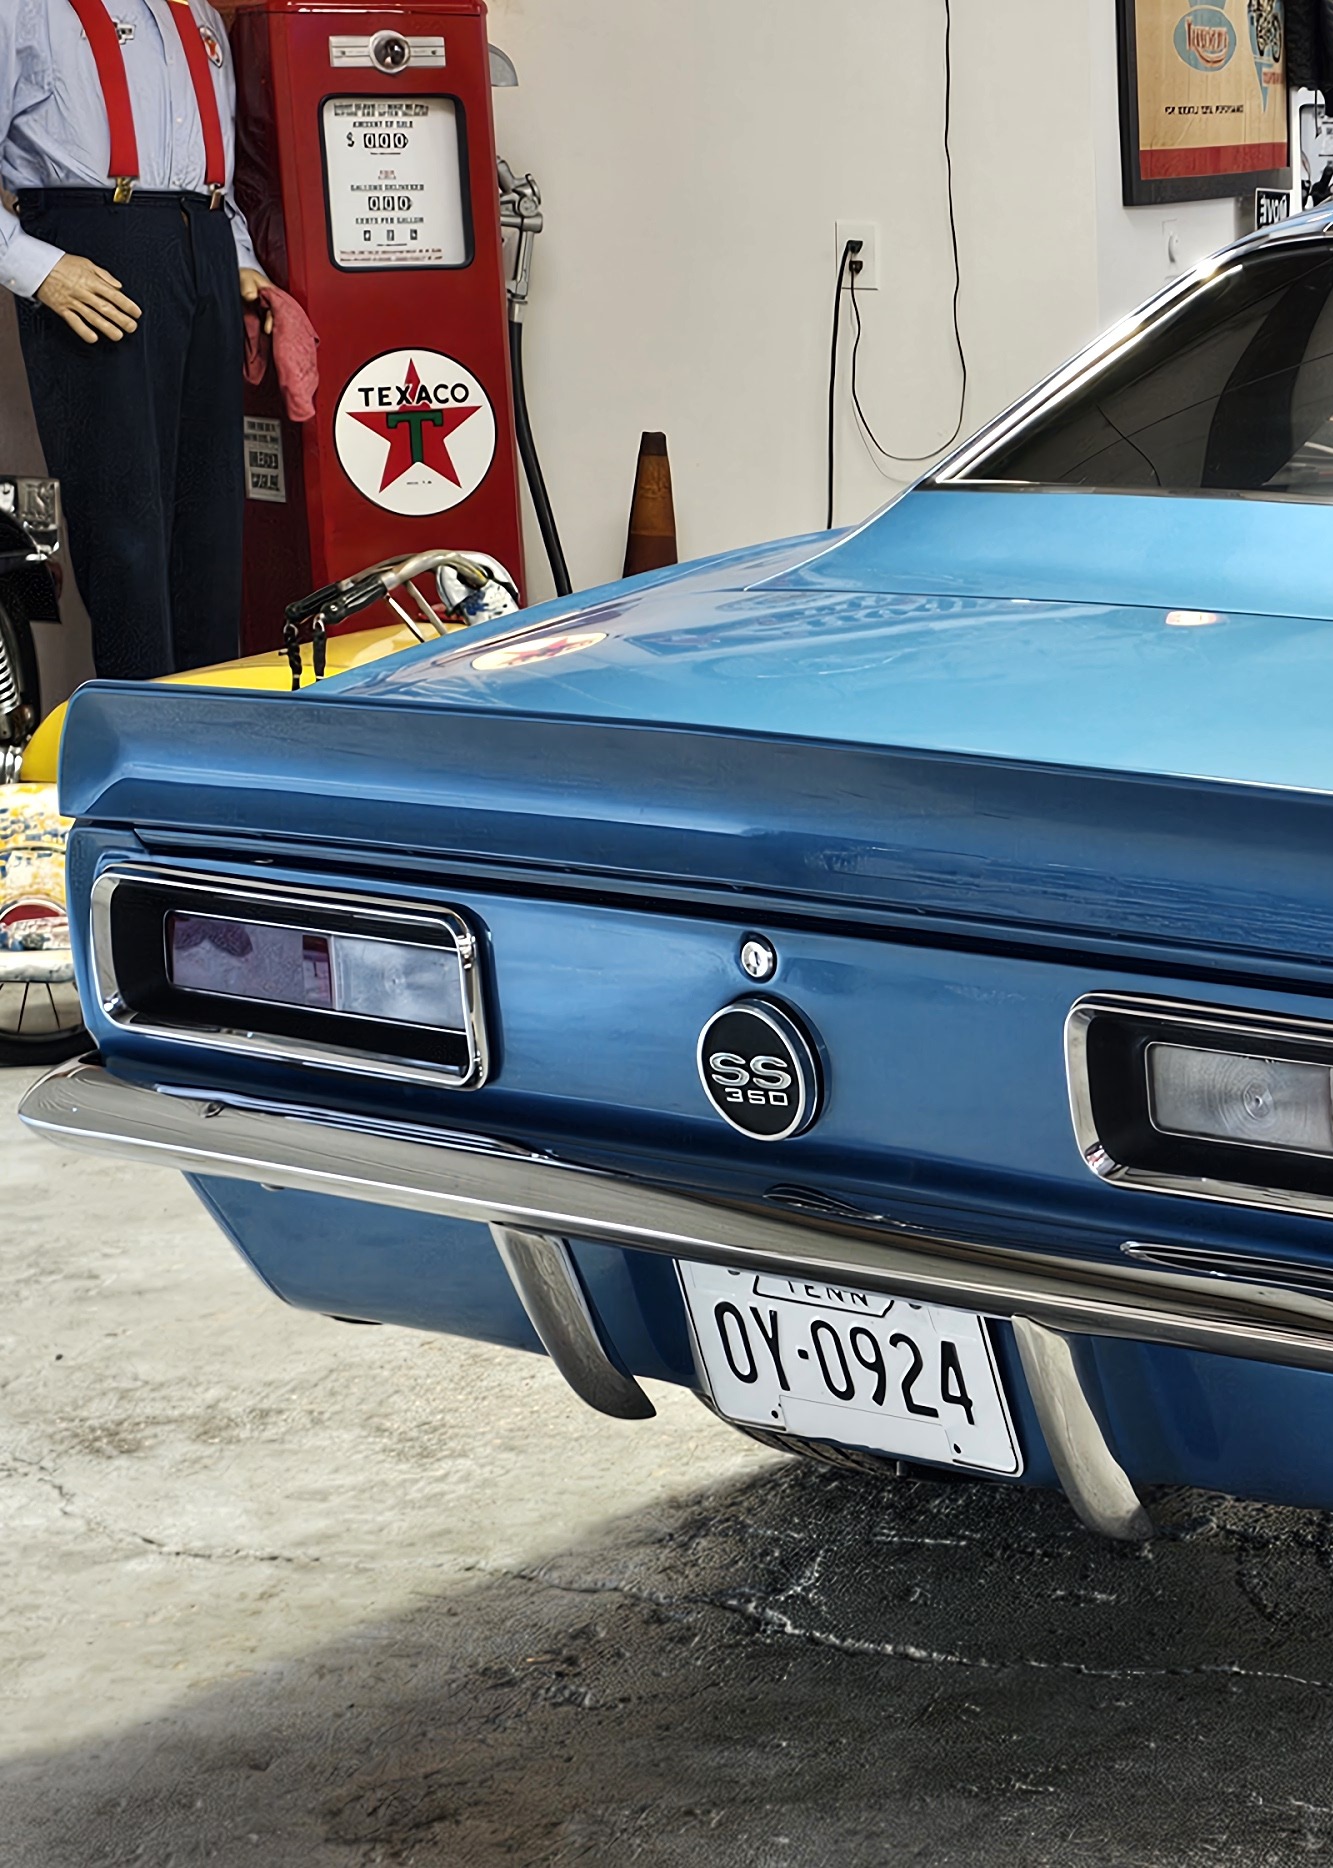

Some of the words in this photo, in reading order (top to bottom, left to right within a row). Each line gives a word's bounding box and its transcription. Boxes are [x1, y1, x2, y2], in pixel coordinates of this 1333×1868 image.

[357, 382, 470, 407] TEXACO
[709, 1051, 792, 1090] SS
[724, 1087, 788, 1106] 350
